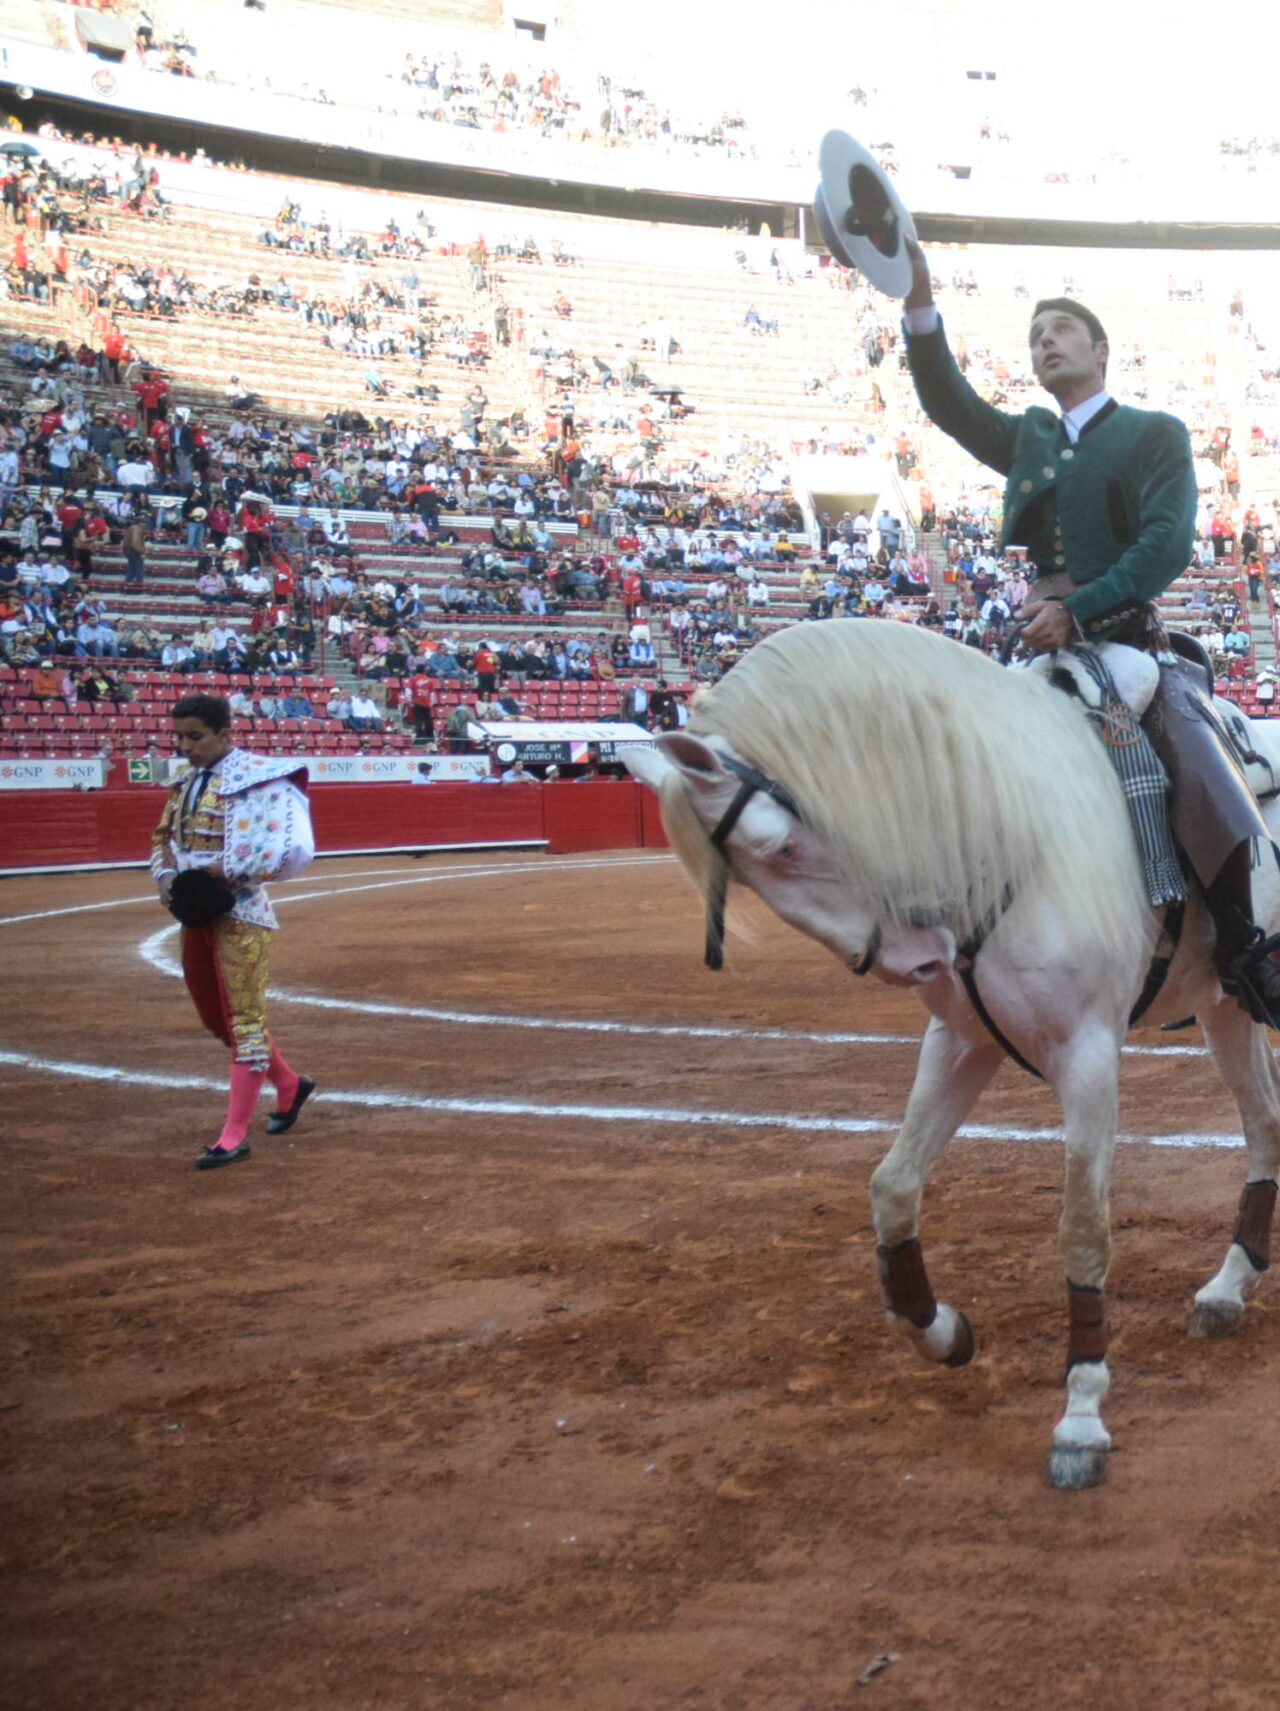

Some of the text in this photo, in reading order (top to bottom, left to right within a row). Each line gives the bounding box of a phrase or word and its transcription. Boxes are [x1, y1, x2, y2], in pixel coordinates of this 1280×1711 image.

[14, 766, 43, 778] GNP
[67, 766, 95, 777] GNP
[328, 762, 353, 772] GNP
[372, 762, 397, 772] GNP
